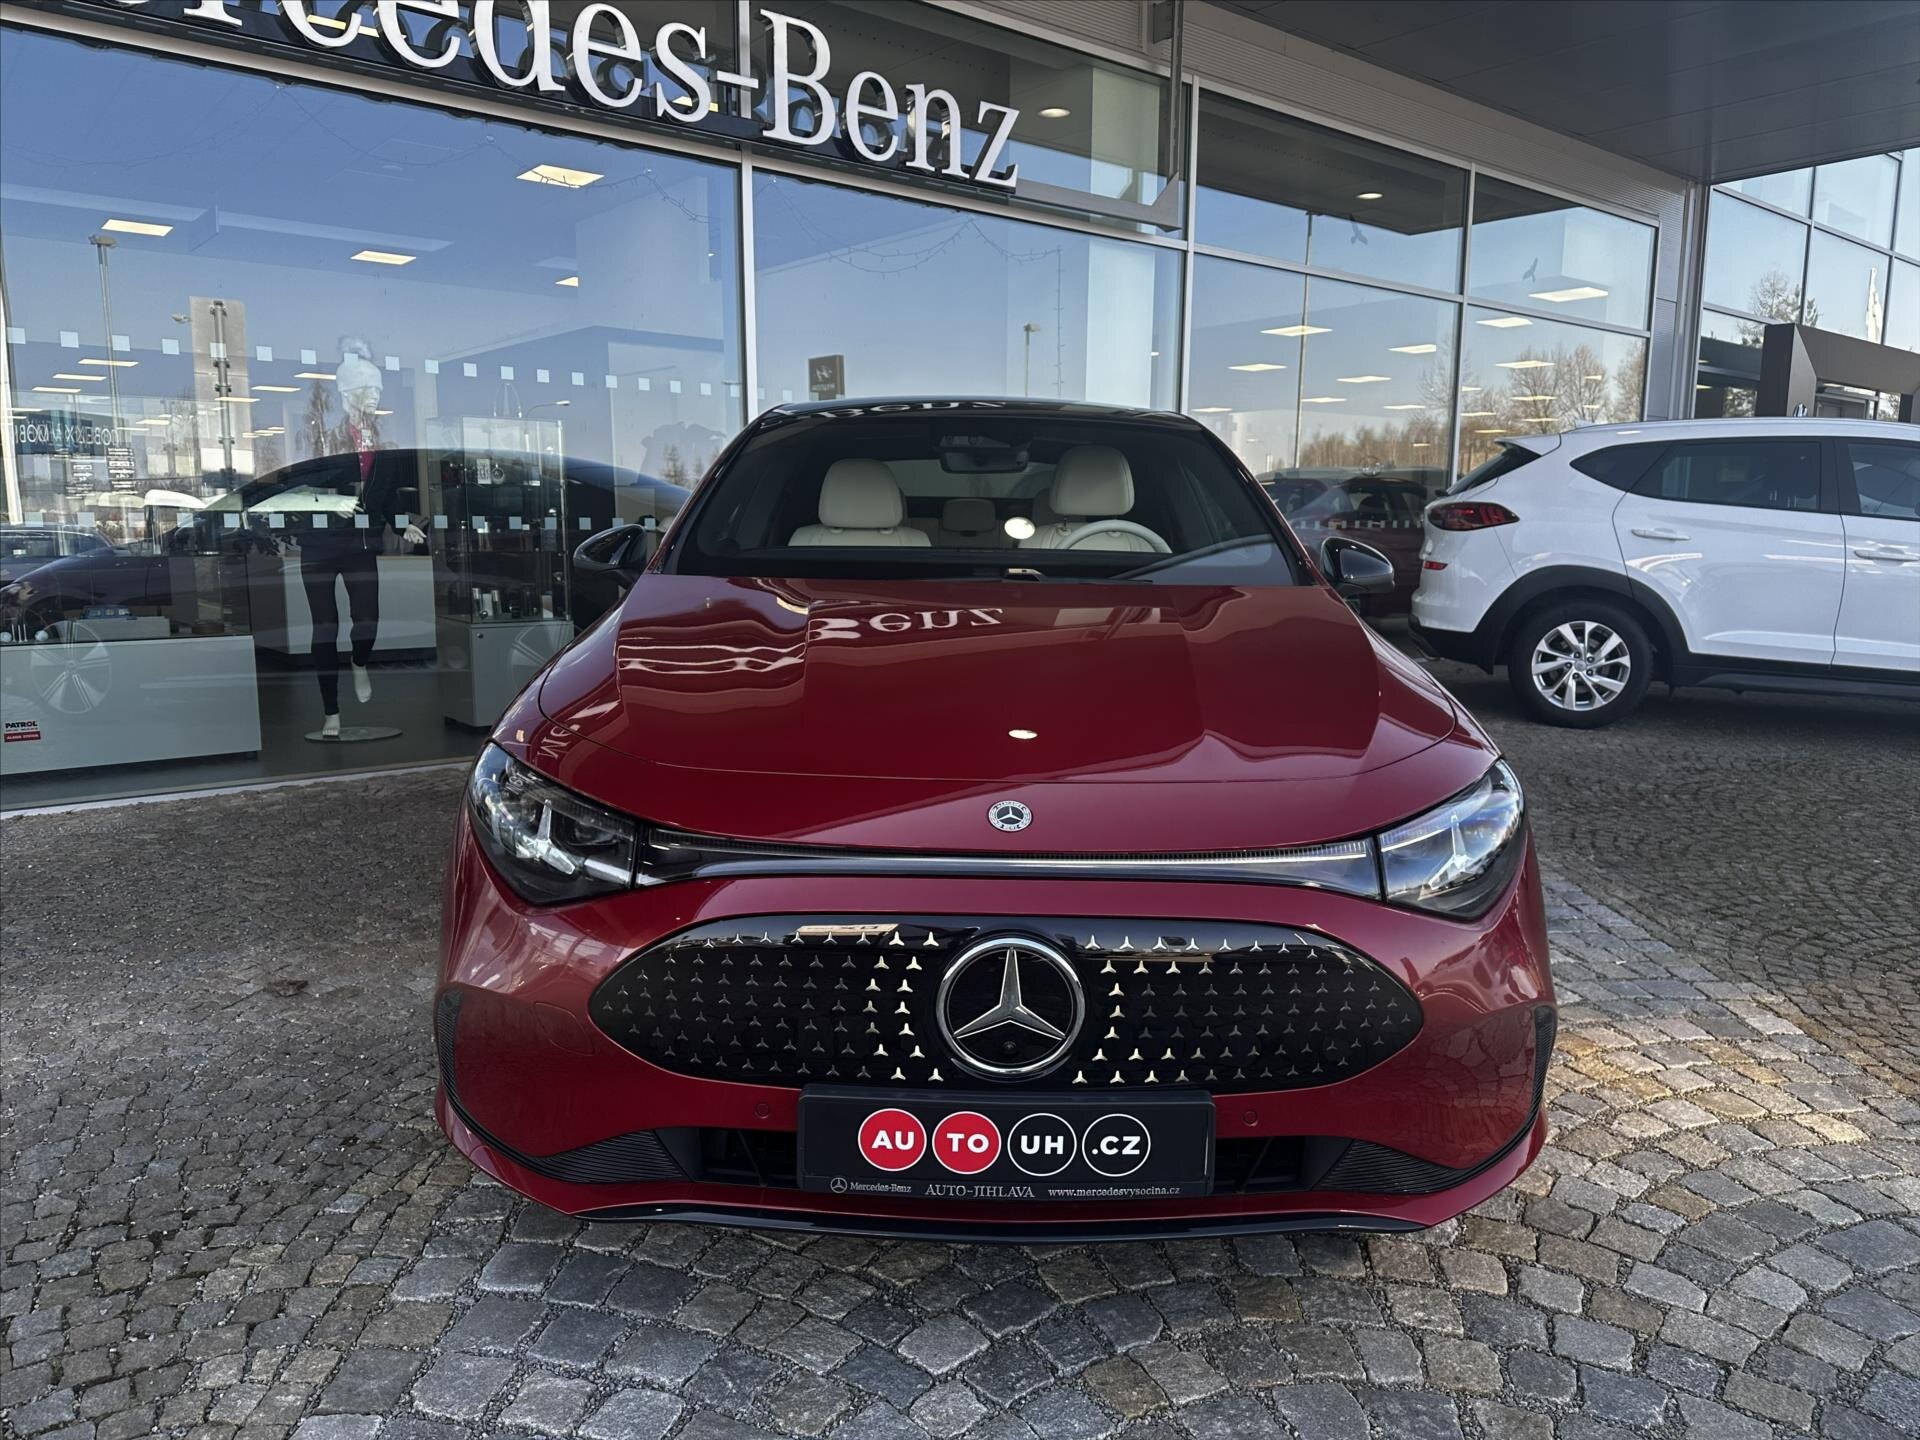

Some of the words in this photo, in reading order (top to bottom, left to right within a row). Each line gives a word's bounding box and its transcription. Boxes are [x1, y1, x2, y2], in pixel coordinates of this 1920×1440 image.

[871, 1130, 915, 1150] AU
[946, 1133, 989, 1153] TO
[1020, 1135, 1064, 1155] UH
[850, 1182, 912, 1193] Mercedes-Benz
[925, 1184, 1035, 1198] AUTO-JIHLAVA
[1048, 1186, 1181, 1197] www.mercedesvysocina.cz
